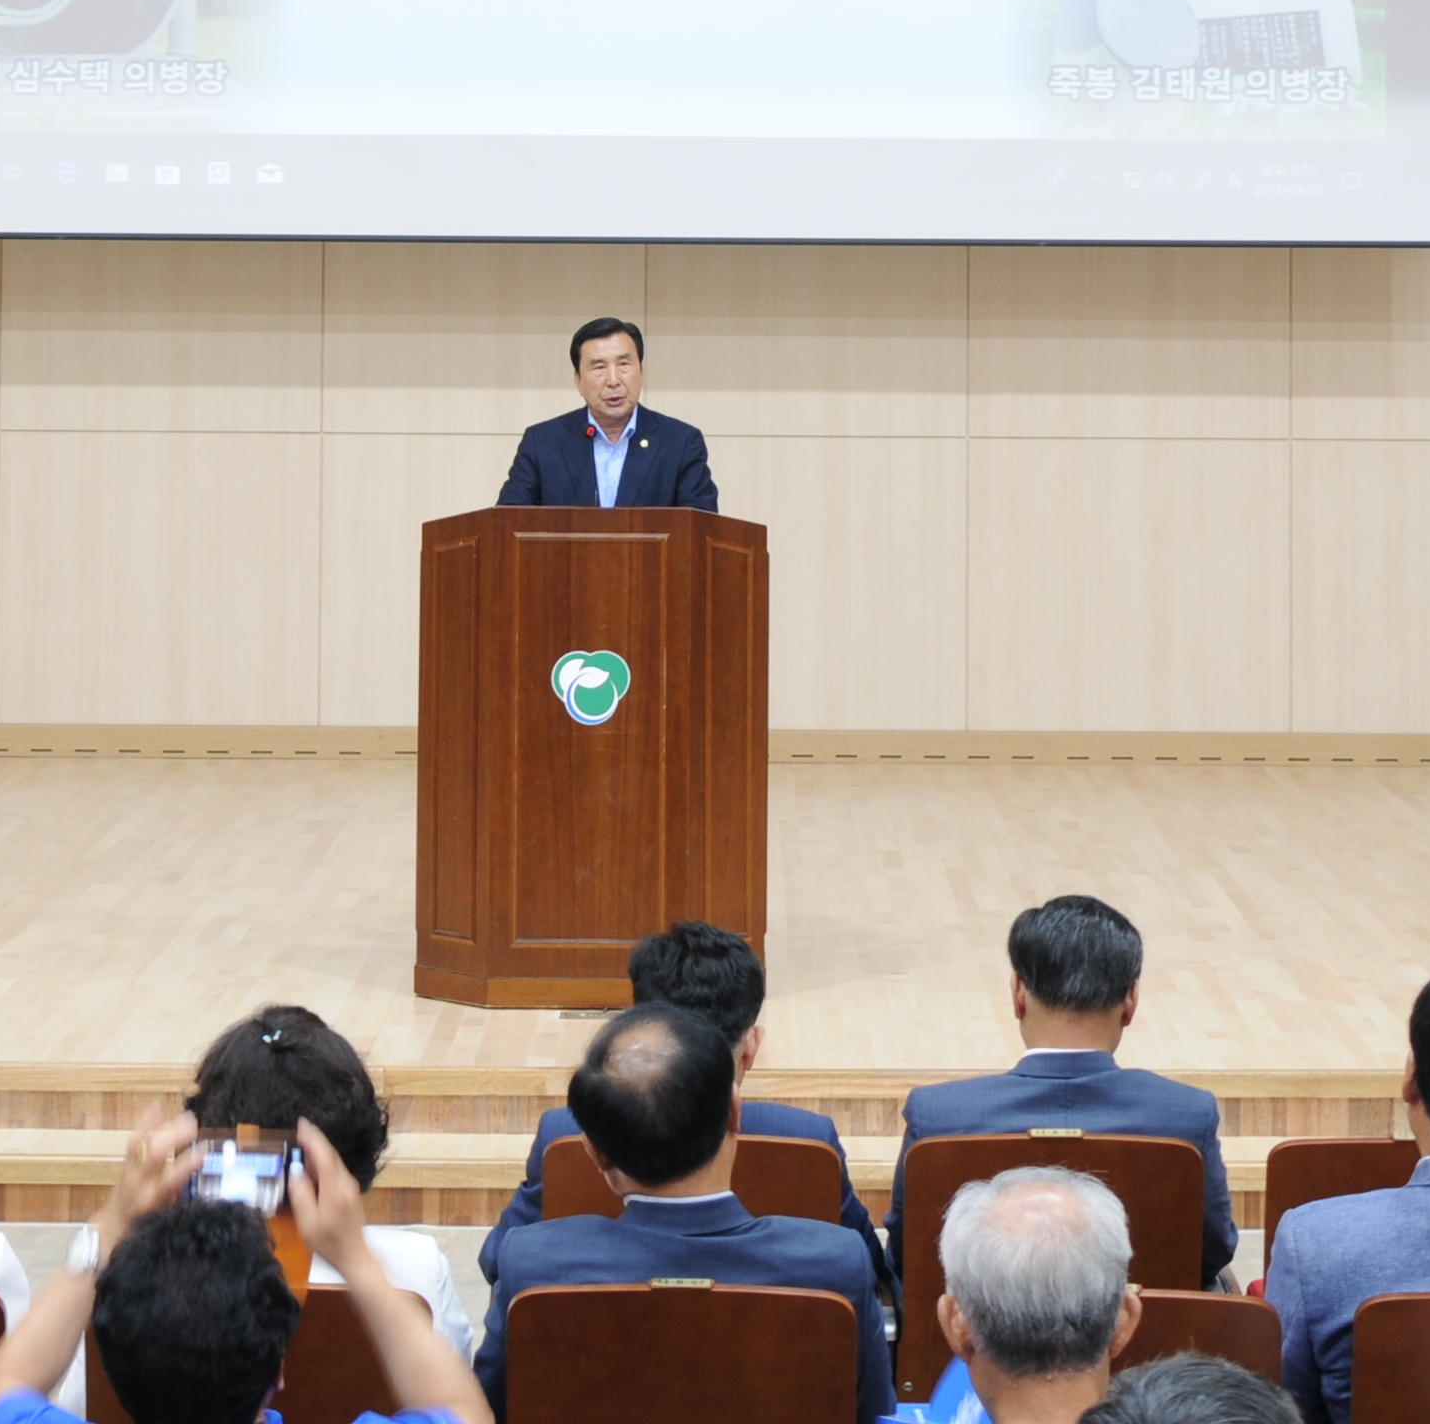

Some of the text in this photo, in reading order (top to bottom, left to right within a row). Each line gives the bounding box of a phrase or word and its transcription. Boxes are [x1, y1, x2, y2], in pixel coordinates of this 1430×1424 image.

[8, 59, 111, 94] 심수택
[123, 60, 227, 95] 의병장
[1048, 67, 1348, 103] 죽봉 김태원 의병장
